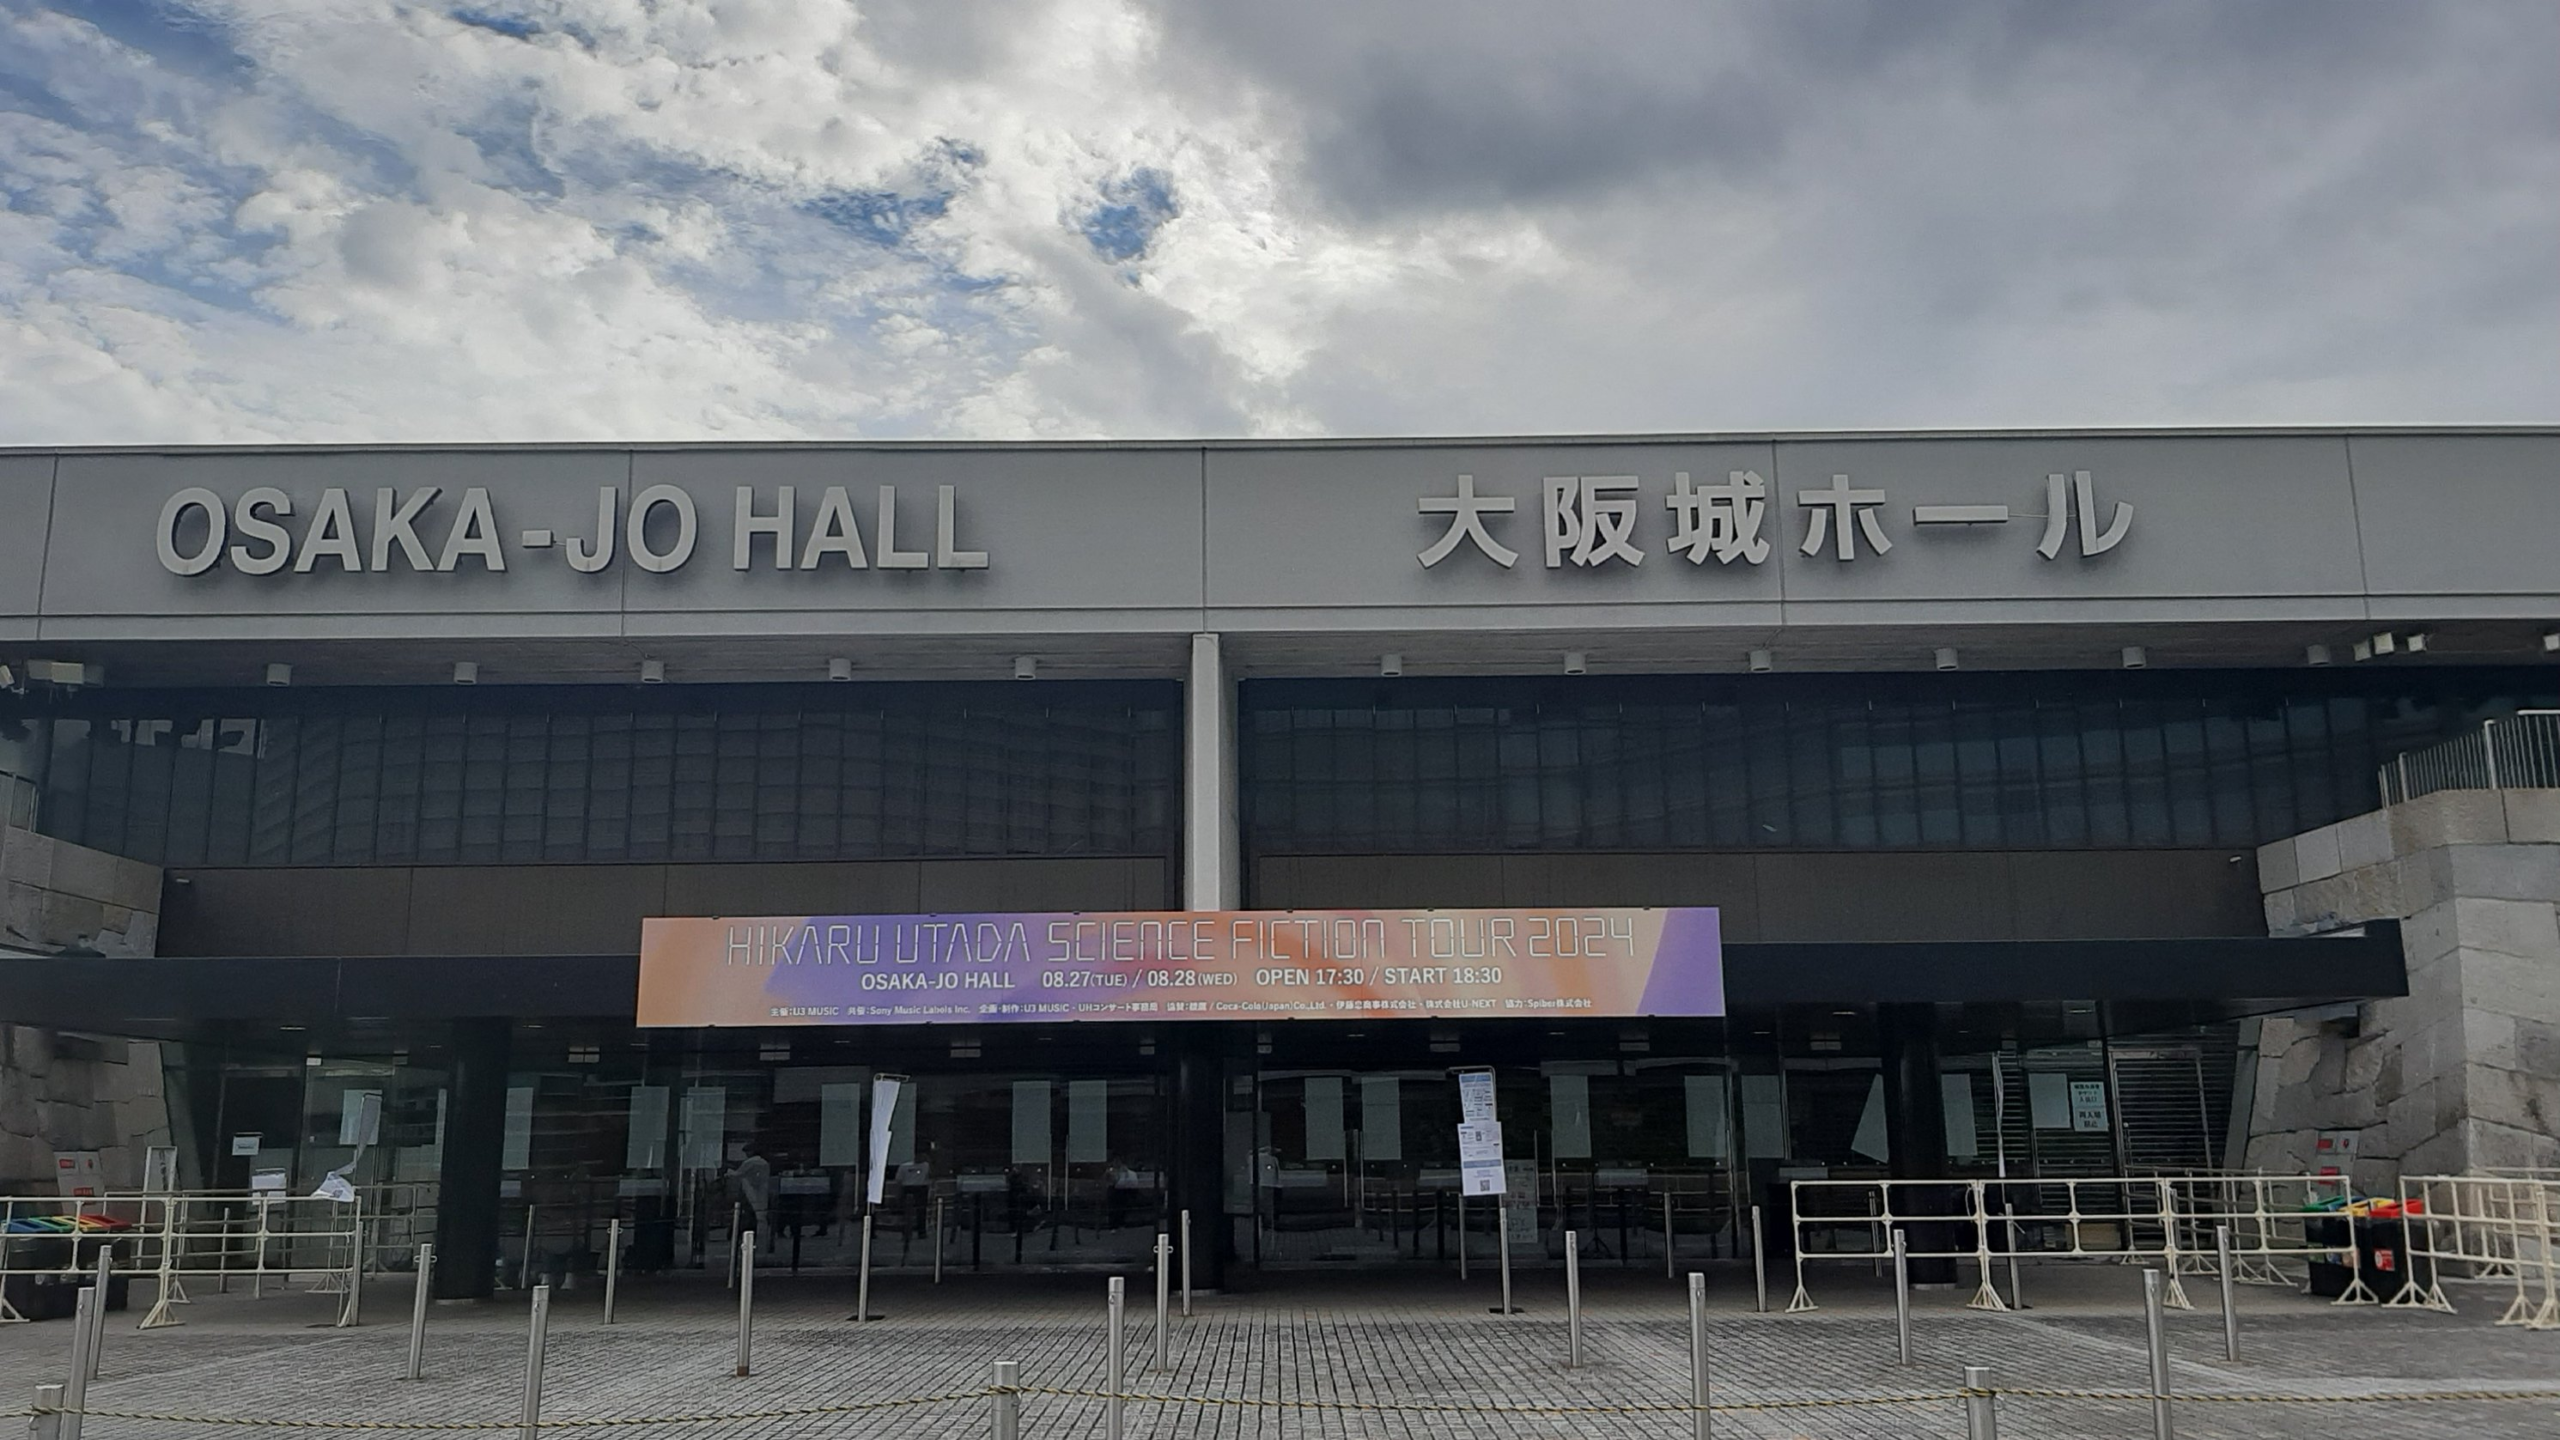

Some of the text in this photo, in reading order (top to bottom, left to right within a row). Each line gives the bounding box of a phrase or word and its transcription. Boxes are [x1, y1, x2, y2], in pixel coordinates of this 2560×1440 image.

[155, 482, 991, 576] OSAKA-JO HALL
[1416, 469, 2135, 570] 大阪城ホール
[728, 916, 1634, 966] HIKARU UTADA SCIENCE FICTION TOUR 2024
[861, 972, 959, 991] OSAKA-JO
[964, 972, 1016, 990] HALL
[1042, 970, 1128, 989] 08.27(TUE)
[1147, 969, 1238, 987] 08.28(WED)
[1256, 969, 1310, 986] OPEN
[1316, 968, 1365, 985] 17:30
[1384, 967, 1448, 985] START
[1453, 967, 1503, 984] 18:30
[807, 1006, 840, 1016] MUSIC
[894, 1005, 922, 1015] Music
[923, 1004, 953, 1014] Labels
[954, 1004, 971, 1014] Inc.
